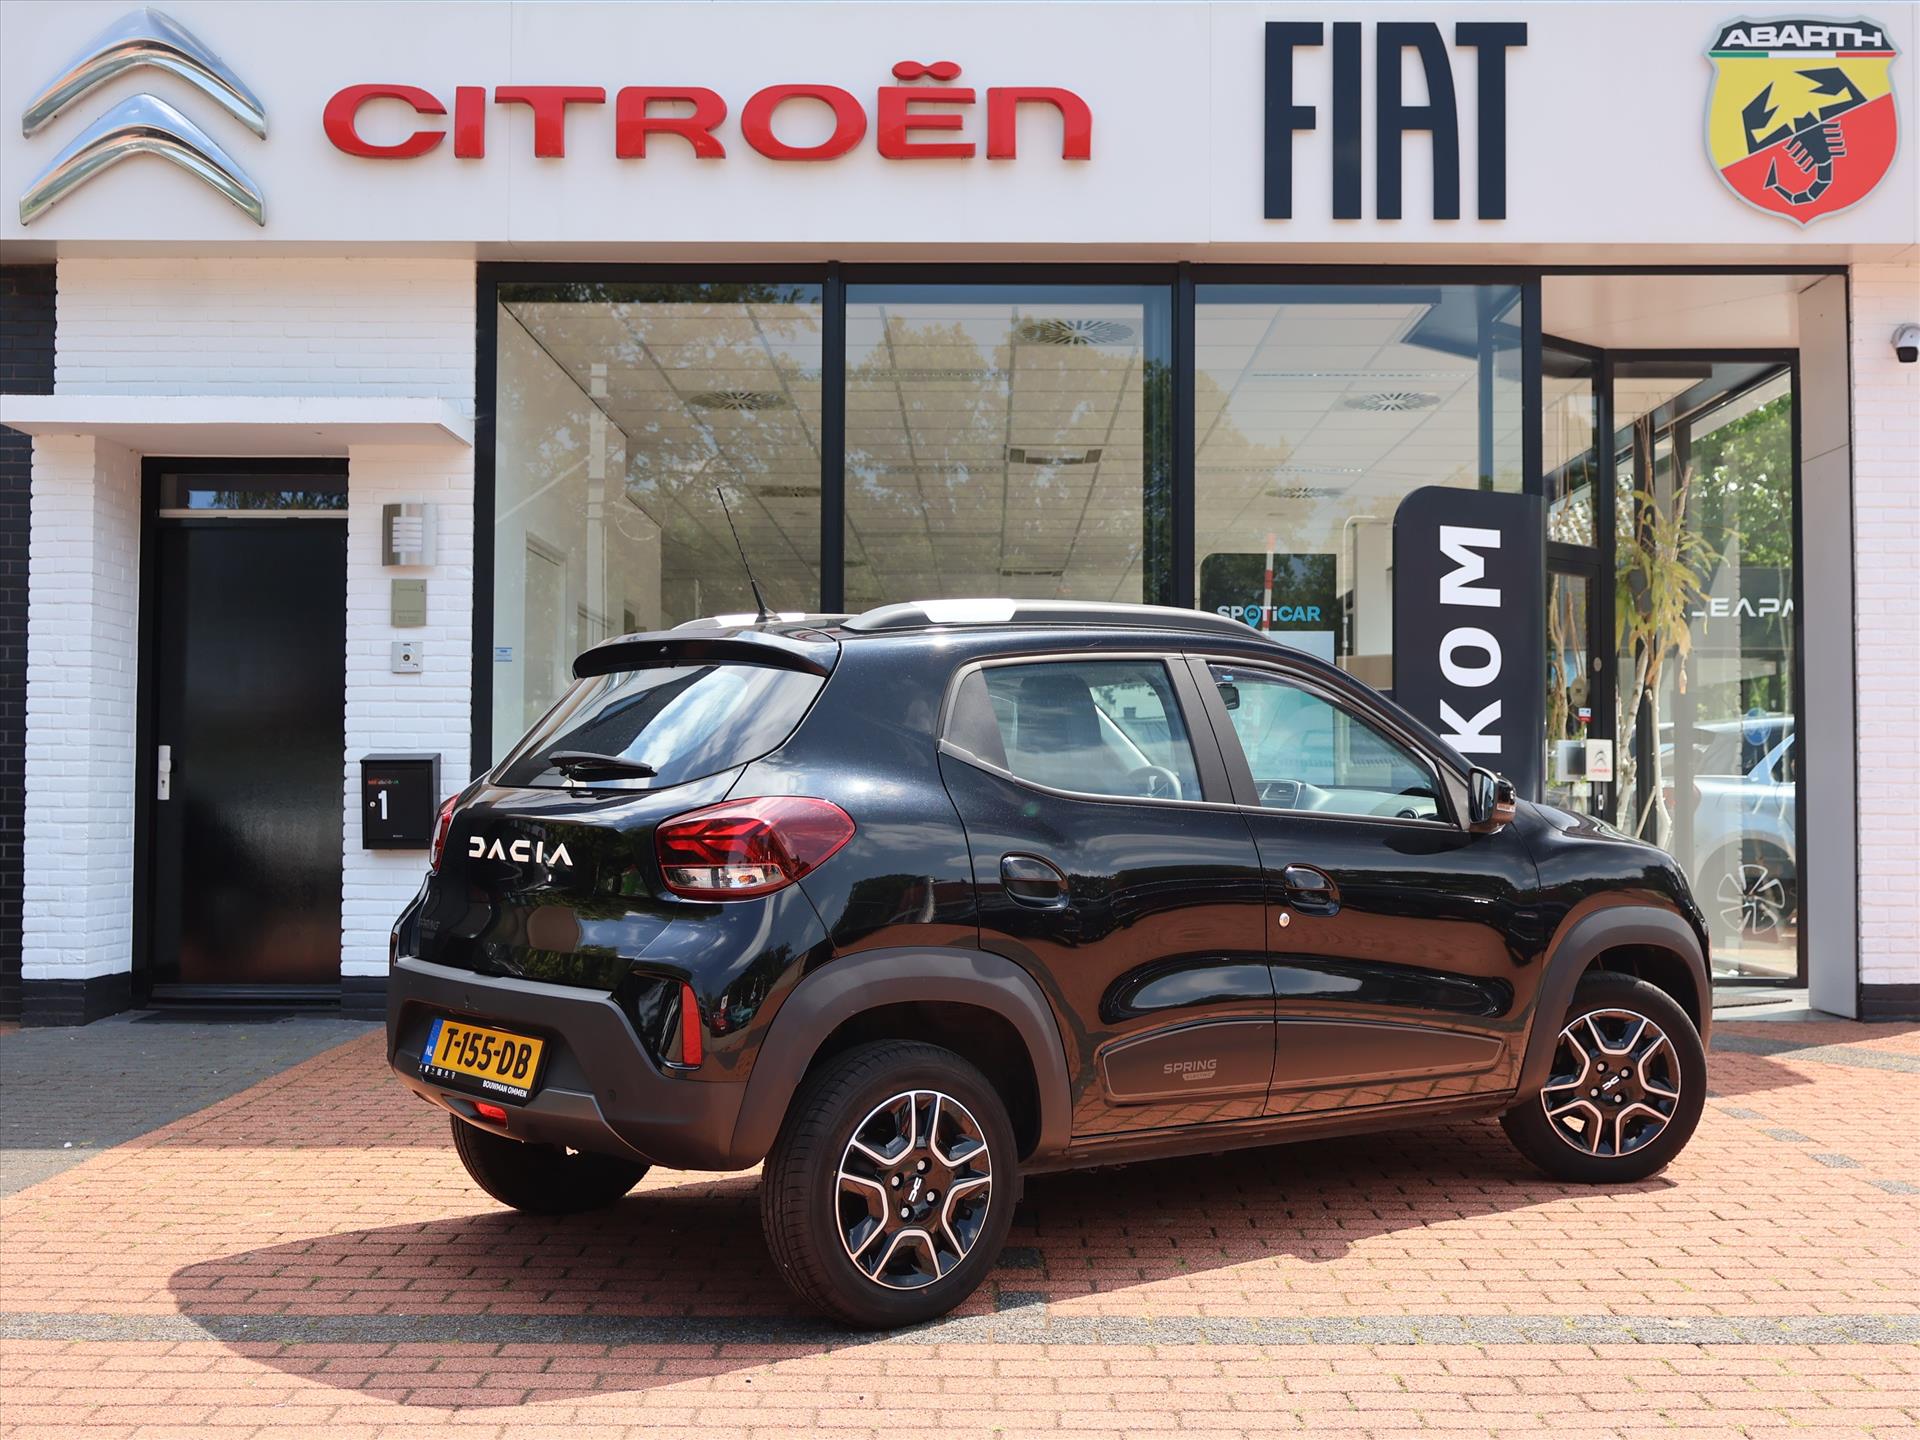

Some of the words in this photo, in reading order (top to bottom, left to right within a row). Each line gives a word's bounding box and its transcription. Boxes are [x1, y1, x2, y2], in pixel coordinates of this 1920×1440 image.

[1722, 25, 1882, 47] ABARTH
[323, 60, 1093, 161] CITROËN
[1264, 22, 1528, 220] FIAT
[377, 789, 388, 820] 1
[468, 835, 574, 867] DACIA
[424, 1045, 433, 1057] NL
[442, 1027, 532, 1080] T-155-DB
[1163, 1059, 1217, 1074] SPRING
[483, 1080, 508, 1093] BOUWMAN
[508, 1086, 528, 1098] OMMEN
